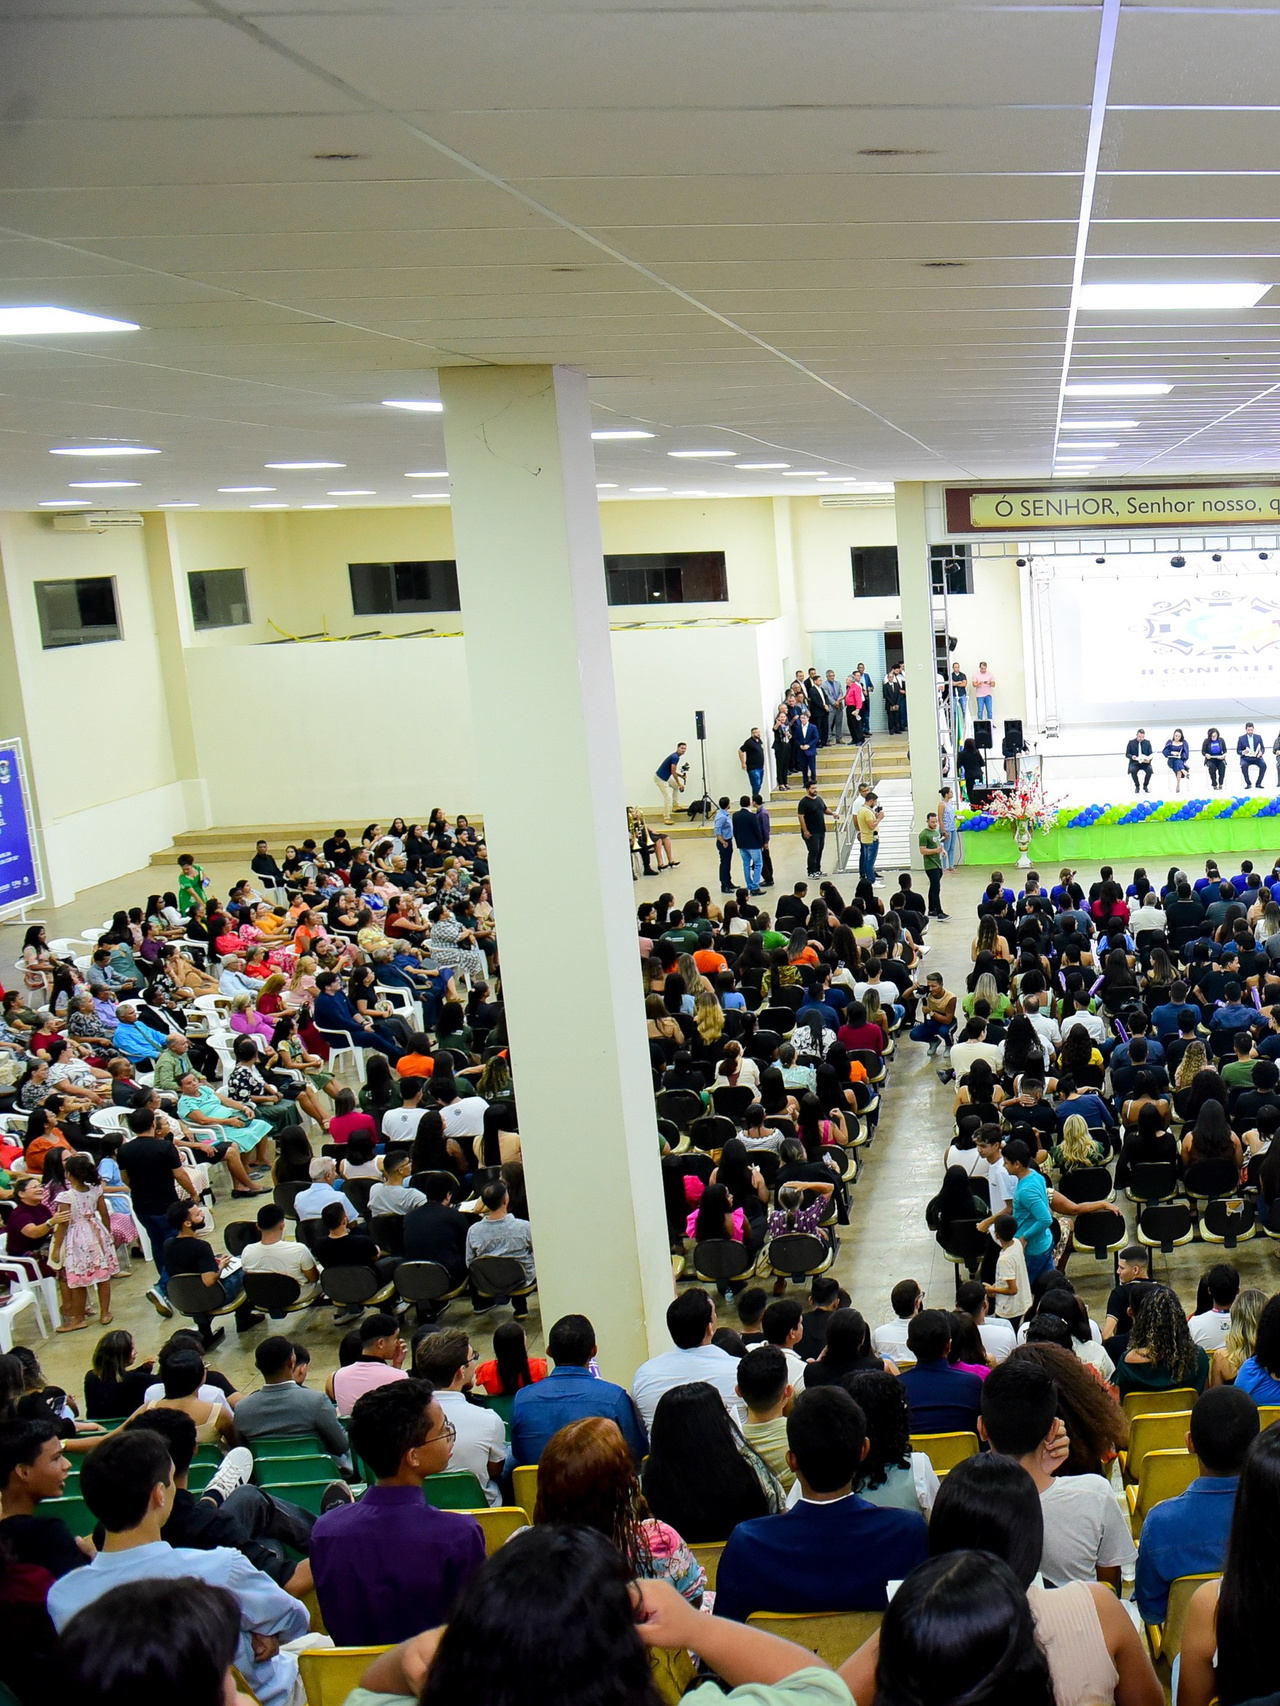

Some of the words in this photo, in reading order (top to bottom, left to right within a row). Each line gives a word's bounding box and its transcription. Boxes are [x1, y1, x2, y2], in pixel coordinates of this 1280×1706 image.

[994, 494, 1014, 517] Ó
[1020, 497, 1120, 518] SENHOR,
[1127, 496, 1195, 514] Senhor
[1202, 498, 1262, 515] nosso,
